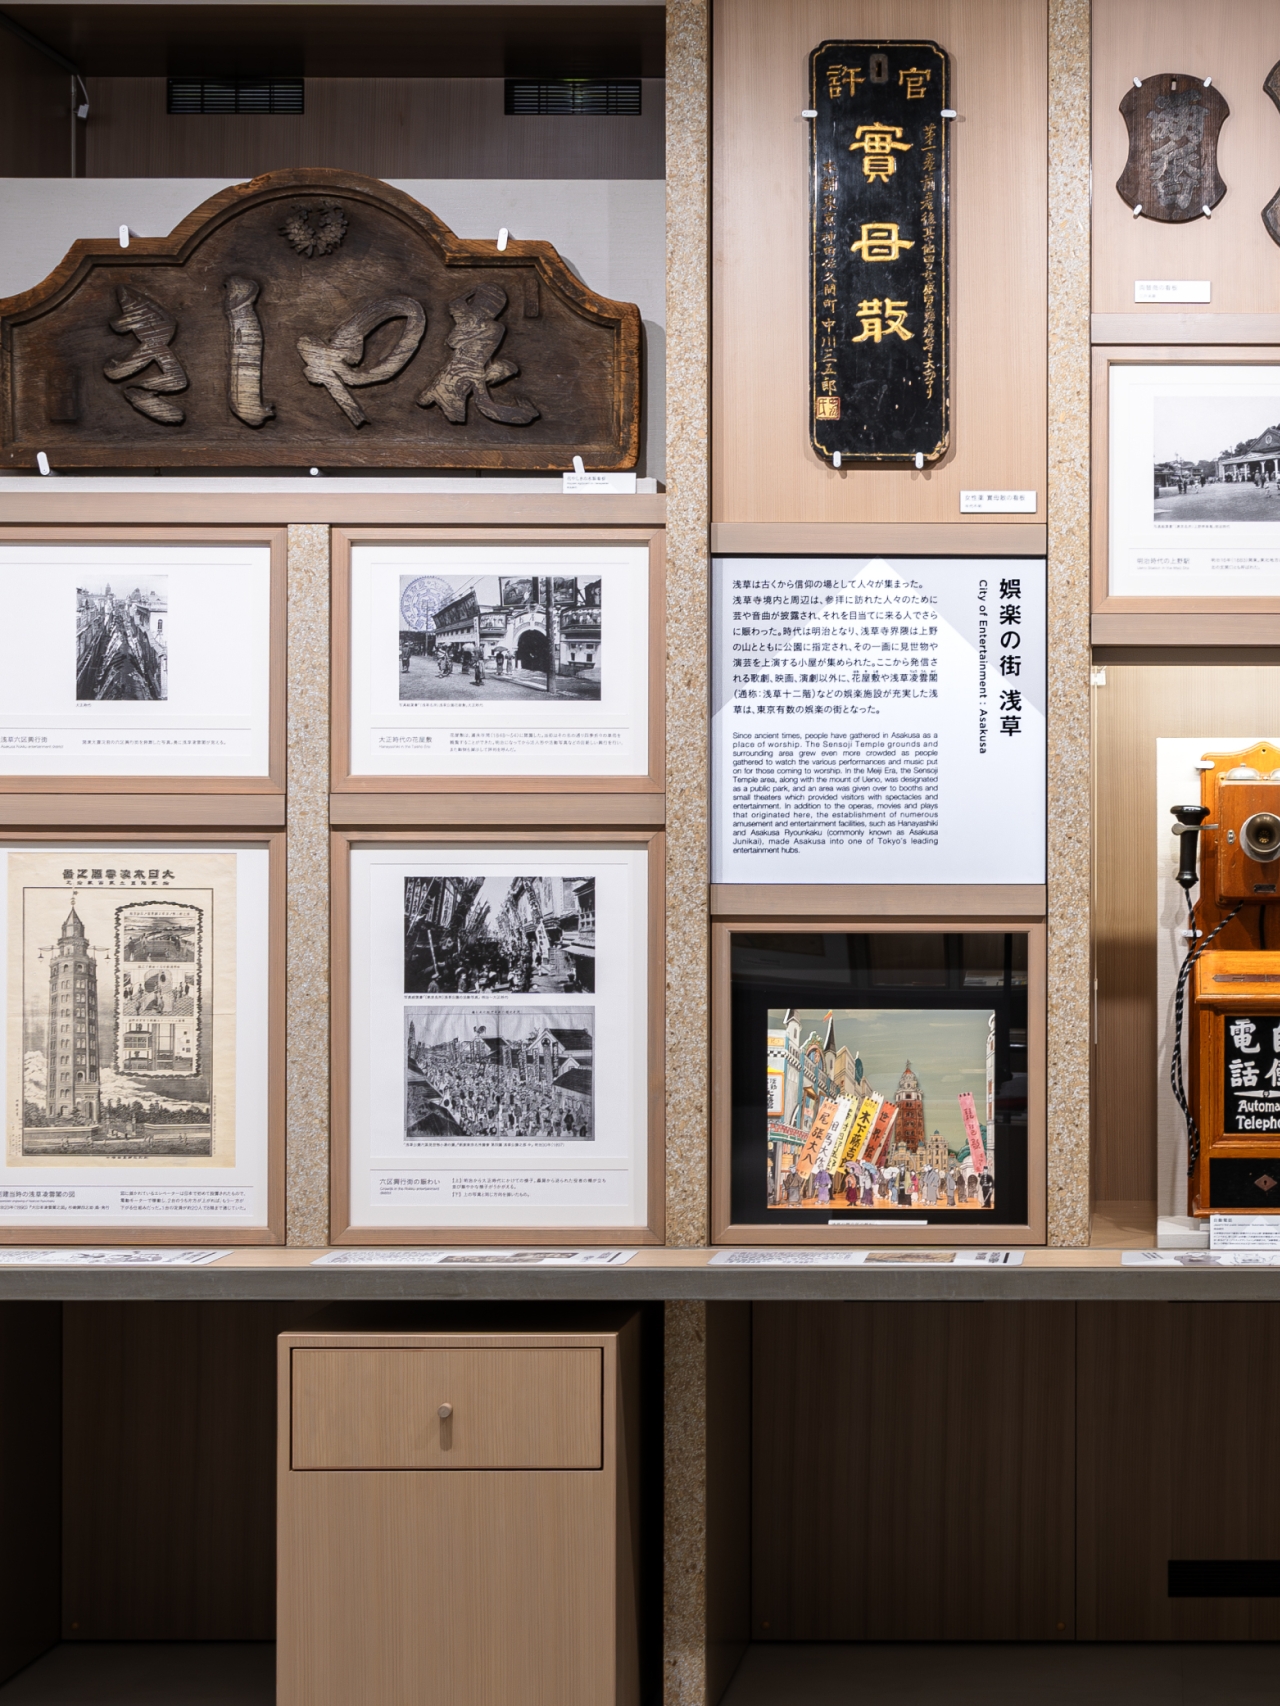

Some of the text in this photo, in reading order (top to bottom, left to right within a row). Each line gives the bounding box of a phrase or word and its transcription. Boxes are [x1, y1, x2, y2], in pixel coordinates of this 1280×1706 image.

[732, 579, 923, 589] 浅草は古くから信仰の場として人々が集まった。
[977, 579, 988, 602] City
[732, 595, 938, 605] 浅草寺境内と周辺は、参拝に訪れた人々のために
[732, 611, 938, 620] 芸や音曲が披露され、それを目当てに来る人でさら
[979, 605, 988, 617] of
[732, 642, 938, 651] の山とともに公園に指定され、その一画に見世物や
[732, 657, 938, 667] 演芸を上演する小屋が集められた。ここから発信さ
[979, 620, 988, 698] Entertainment
[999, 578, 1022, 737] 娯楽の街 浅草
[733, 704, 880, 714] 草は、東京有数の娯楽の街となった。
[979, 708, 988, 754] Asakusa
[781, 732, 802, 740] times,
[805, 732, 828, 740] people
[849, 732, 880, 740] gathered
[733, 741, 755, 749] place
[768, 741, 802, 749] worship.
[823, 741, 852, 749] Sensoji
[855, 741, 885, 749] Temple
[887, 741, 920, 749] grounds
[733, 749, 773, 758] surrounding
[915, 749, 938, 758] people
[732, 758, 763, 766] gathered
[839, 758, 886, 766] performances
[926, 758, 938, 766] put
[777, 767, 802, 775] coming
[813, 767, 842, 775] worship.
[867, 767, 882, 775] Meiji
[884, 767, 898, 775] Era,
[913, 767, 938, 775] Sensoji
[733, 776, 759, 784] Temple
[779, 776, 798, 784] along
[862, 776, 882, 784] Ueno,
[900, 776, 938, 784] designated
[750, 784, 770, 793] public
[772, 784, 790, 793] park,
[852, 784, 870, 793] given
[808, 793, 838, 801] provided
[885, 793, 922, 801] spectacles
[1229, 1019, 1261, 1088] 電話
[801, 1111, 831, 1166] 尾張大八
[378, 1178, 441, 1186] 六区興行街の賑わい
